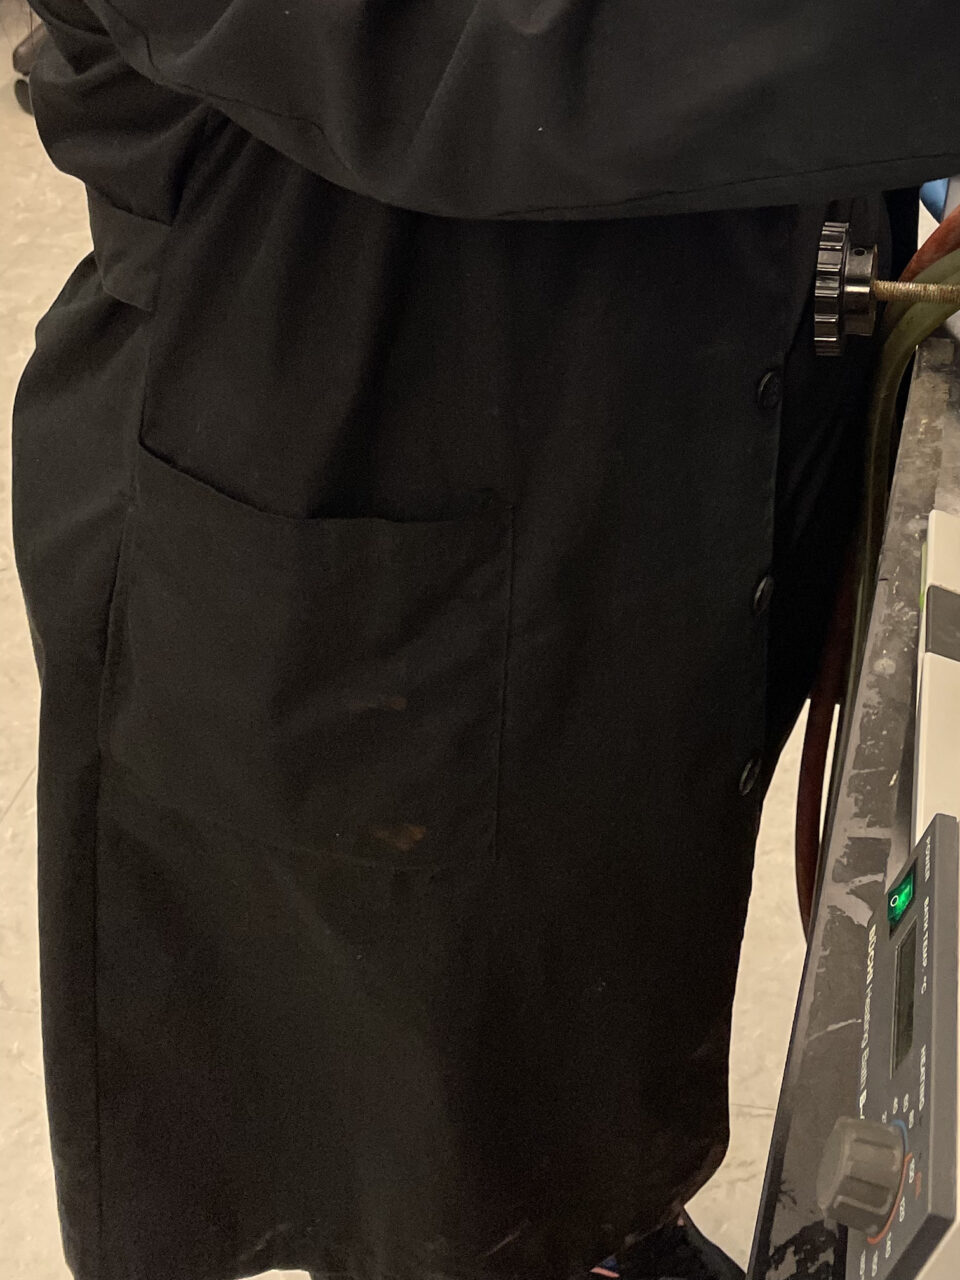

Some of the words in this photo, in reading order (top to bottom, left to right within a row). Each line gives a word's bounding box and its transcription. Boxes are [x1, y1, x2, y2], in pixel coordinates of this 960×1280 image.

[922, 895, 930, 933] BATH
[866, 923, 877, 985] BÜCHI
[920, 975, 928, 995] °C
[861, 983, 873, 1049] Heating
[860, 1046, 870, 1091] Bath
[918, 1043, 927, 1112] HEATING
